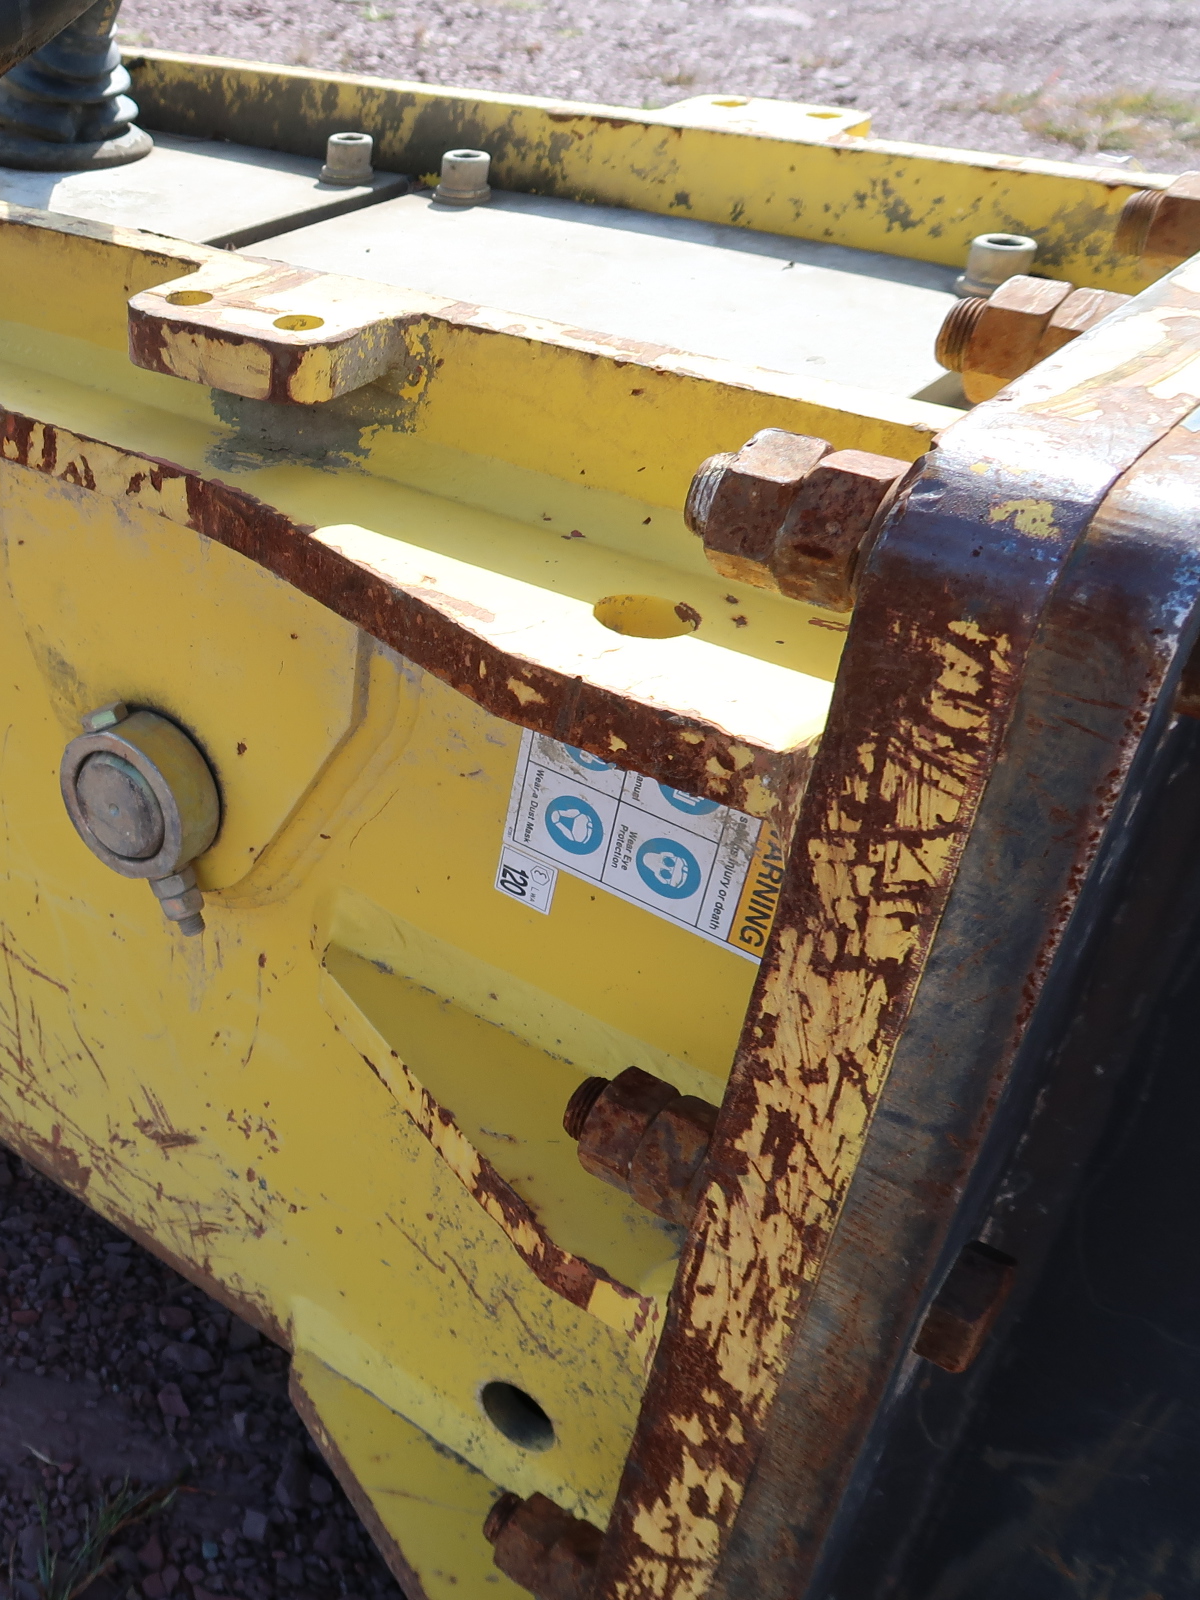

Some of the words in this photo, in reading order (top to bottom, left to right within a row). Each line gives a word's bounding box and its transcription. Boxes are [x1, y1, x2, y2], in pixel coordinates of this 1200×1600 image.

[533, 769, 545, 791] Wear
[632, 772, 643, 801] anual
[527, 801, 539, 821] Dust
[523, 822, 535, 843] Mask
[628, 832, 638, 854] Wear
[611, 823, 629, 869] Protection
[620, 855, 632, 871] Eye
[720, 858, 736, 888] injury
[500, 864, 530, 896] 120
[739, 829, 784, 948] ARNING
[718, 889, 727, 902] or
[709, 901, 725, 930] death
